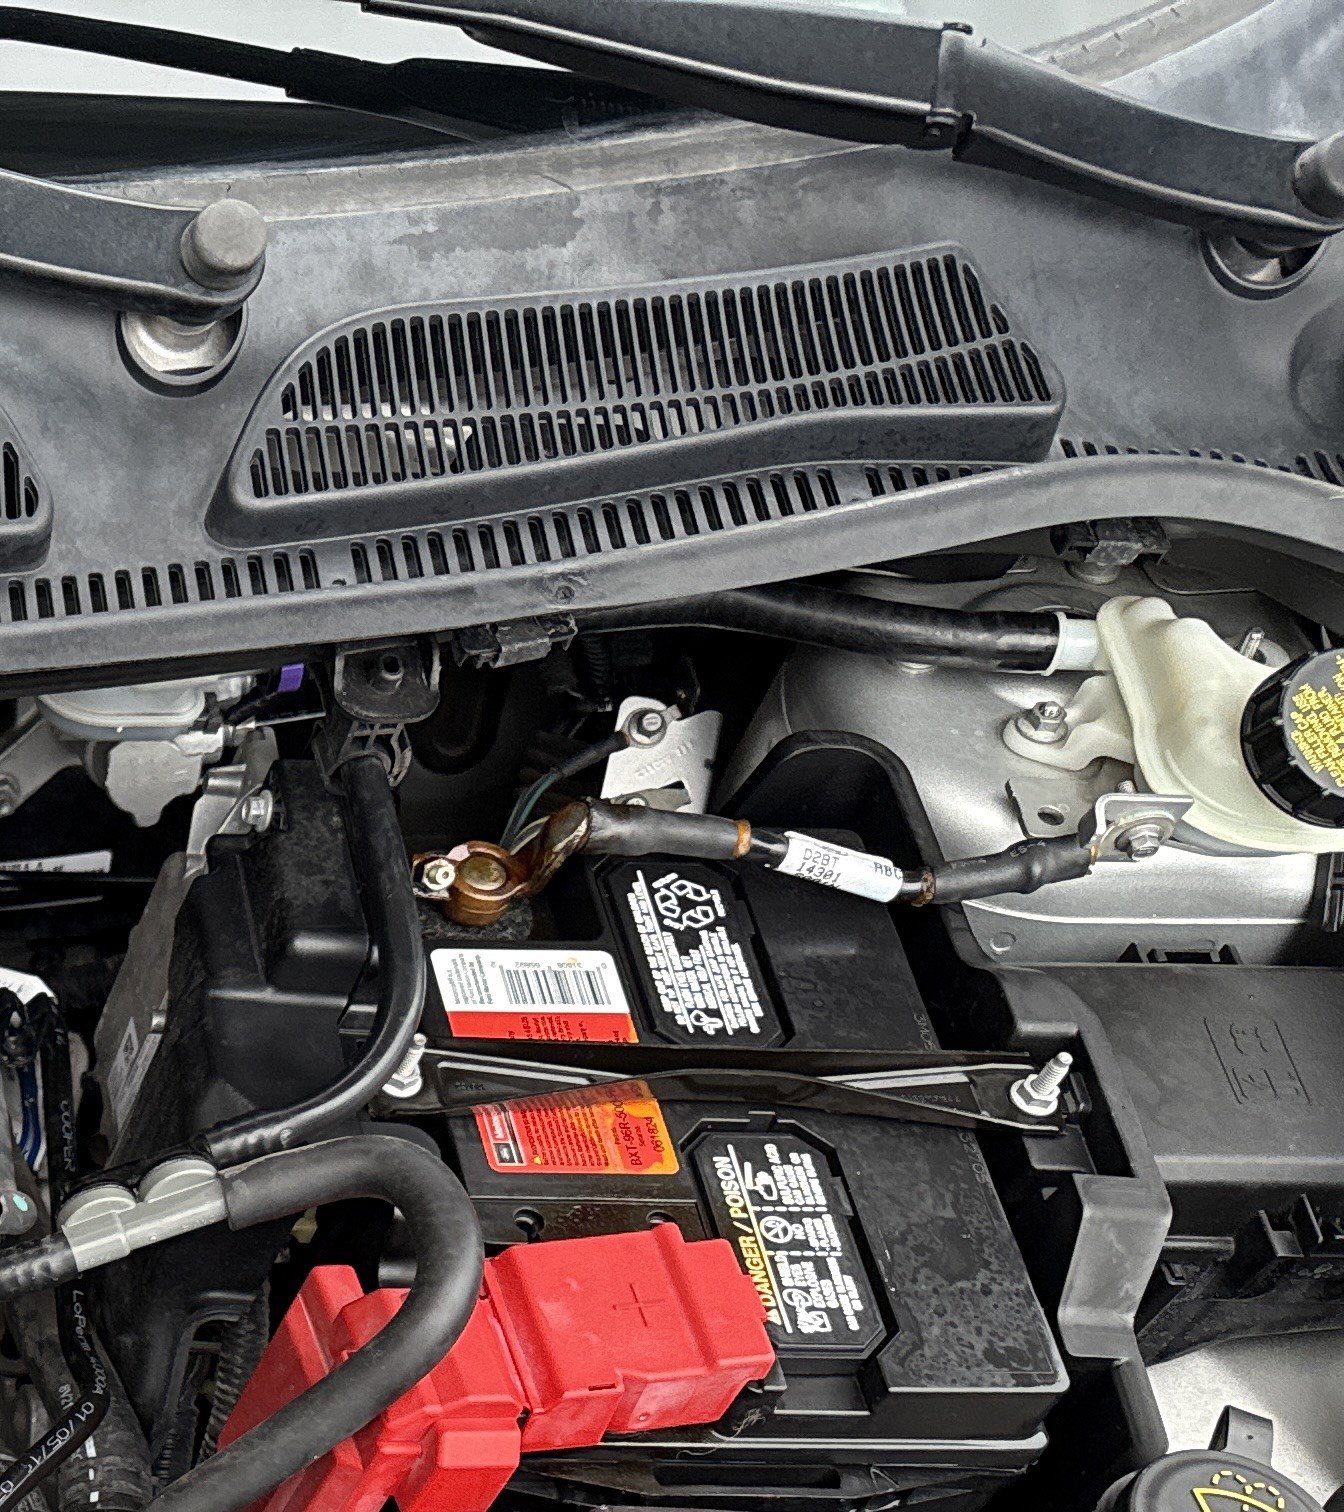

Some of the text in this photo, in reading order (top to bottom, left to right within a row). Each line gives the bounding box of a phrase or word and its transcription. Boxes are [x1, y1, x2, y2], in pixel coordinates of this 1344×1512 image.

[1288, 707, 1310, 731] CAP
[801, 847, 840, 869] D2BT
[711, 1155, 749, 1218] POISON
[737, 1235, 778, 1306] DANGER
